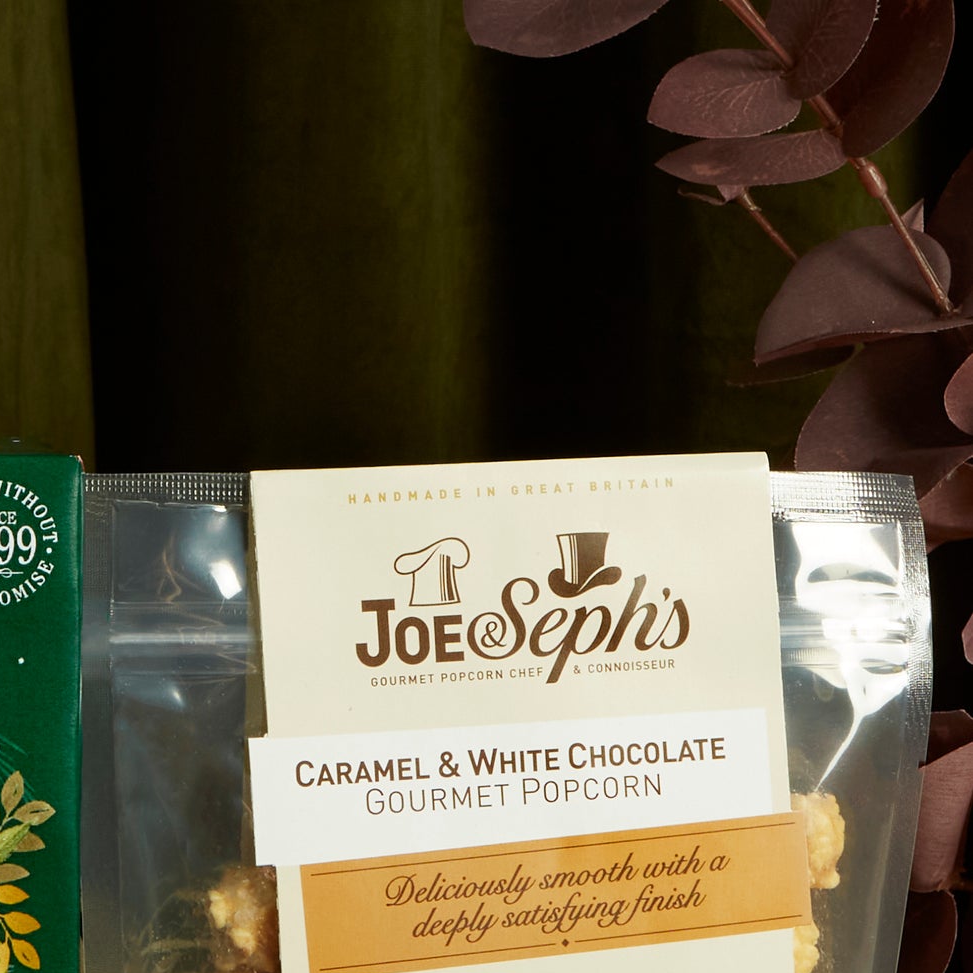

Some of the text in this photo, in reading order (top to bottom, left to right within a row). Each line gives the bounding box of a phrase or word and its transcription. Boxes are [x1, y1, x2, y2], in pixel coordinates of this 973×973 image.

[347, 477, 675, 505] HANDMADE IN GREAT BRITAIN
[370, 673, 435, 688] GOURMET
[440, 669, 504, 683] POPCORN
[509, 666, 544, 678] CHEF
[587, 658, 676, 673] CONNOISSEUR
[295, 757, 430, 788] CARAMEL
[467, 747, 560, 775] WHITE
[568, 737, 726, 770] CHOCOLATE
[365, 773, 662, 815] GOURMET POPCORN
[385, 845, 730, 908] Deliciously smooth with a
[412, 879, 706, 947] deeply satisfying finish
